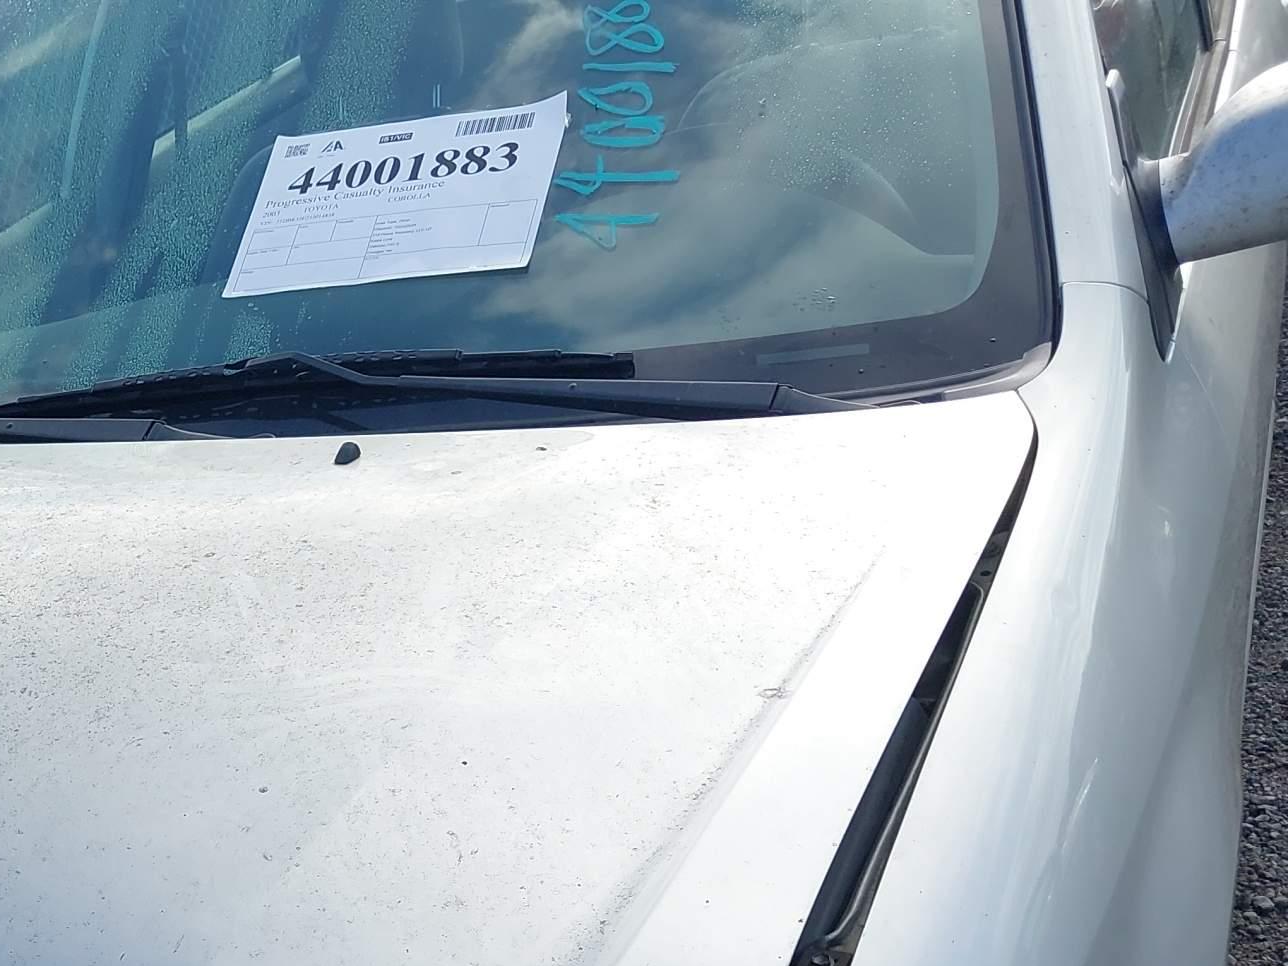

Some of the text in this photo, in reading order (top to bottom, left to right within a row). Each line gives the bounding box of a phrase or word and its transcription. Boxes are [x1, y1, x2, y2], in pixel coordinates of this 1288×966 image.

[288, 142, 520, 195] 44001883
[265, 181, 445, 209] Progressive Casualty Insurance
